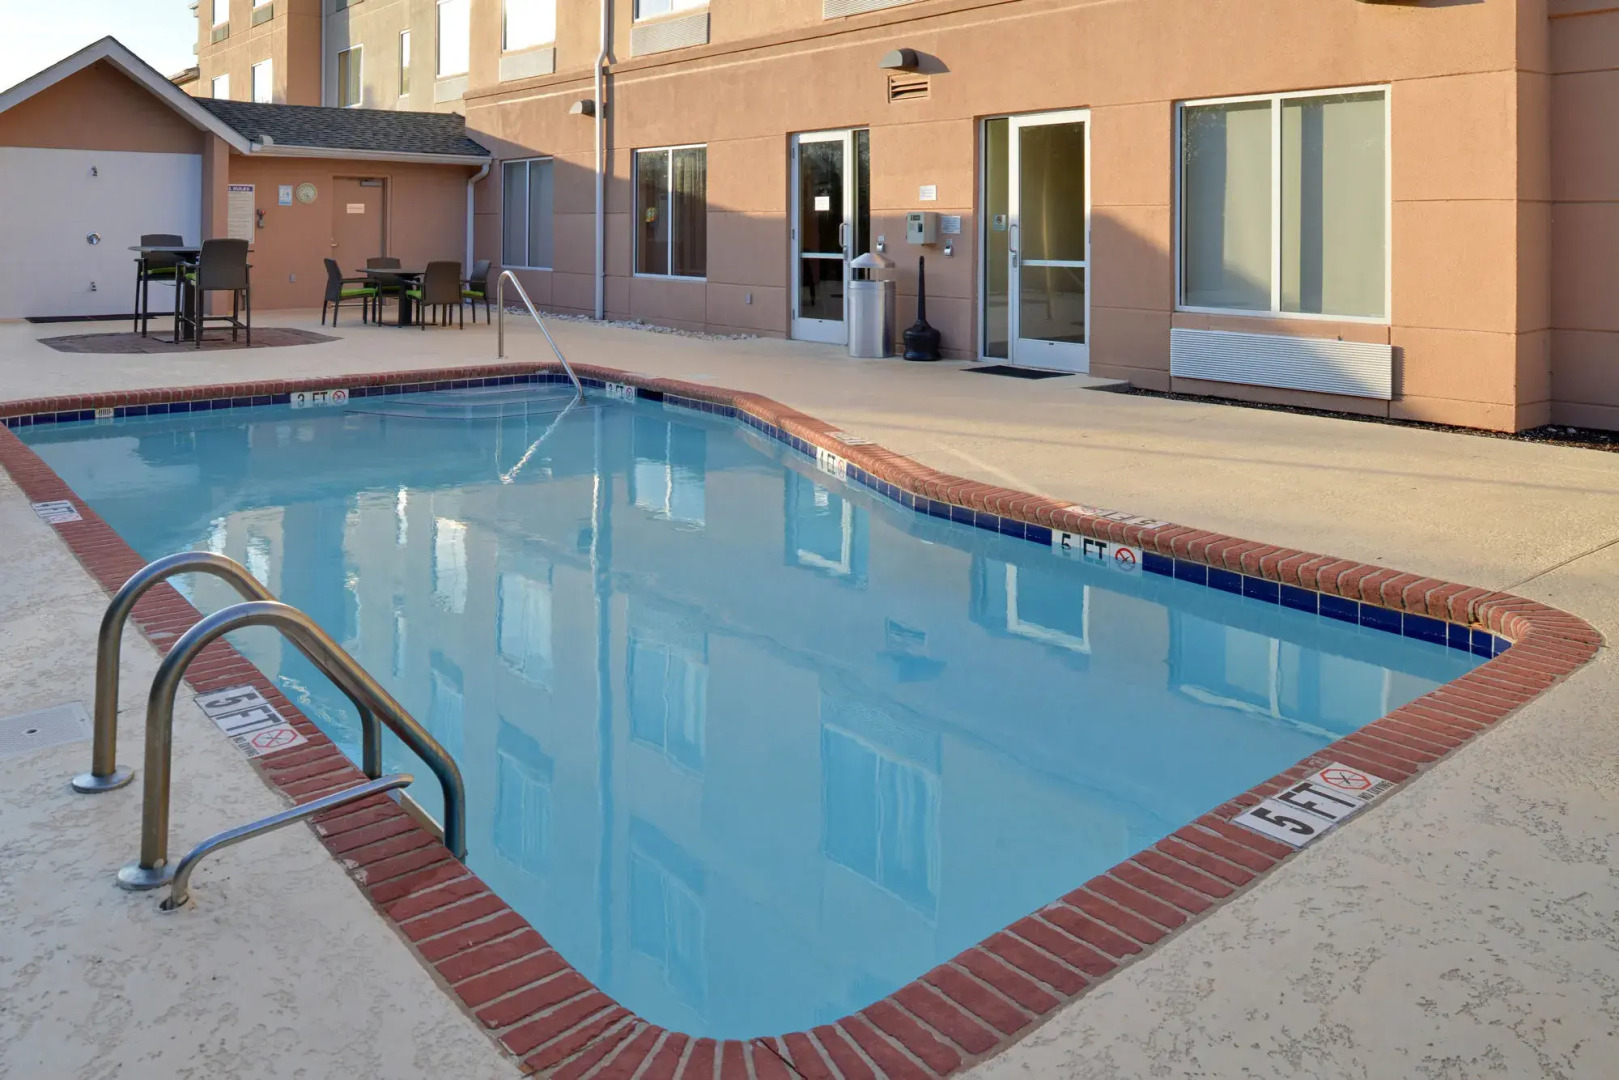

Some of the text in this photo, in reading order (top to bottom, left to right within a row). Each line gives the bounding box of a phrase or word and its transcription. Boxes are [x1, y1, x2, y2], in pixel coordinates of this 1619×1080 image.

[312, 391, 328, 402] FT
[1061, 533, 1107, 559] 5 FT
[205, 693, 281, 731] 5 FT
[1250, 782, 1356, 835] 5 FT
